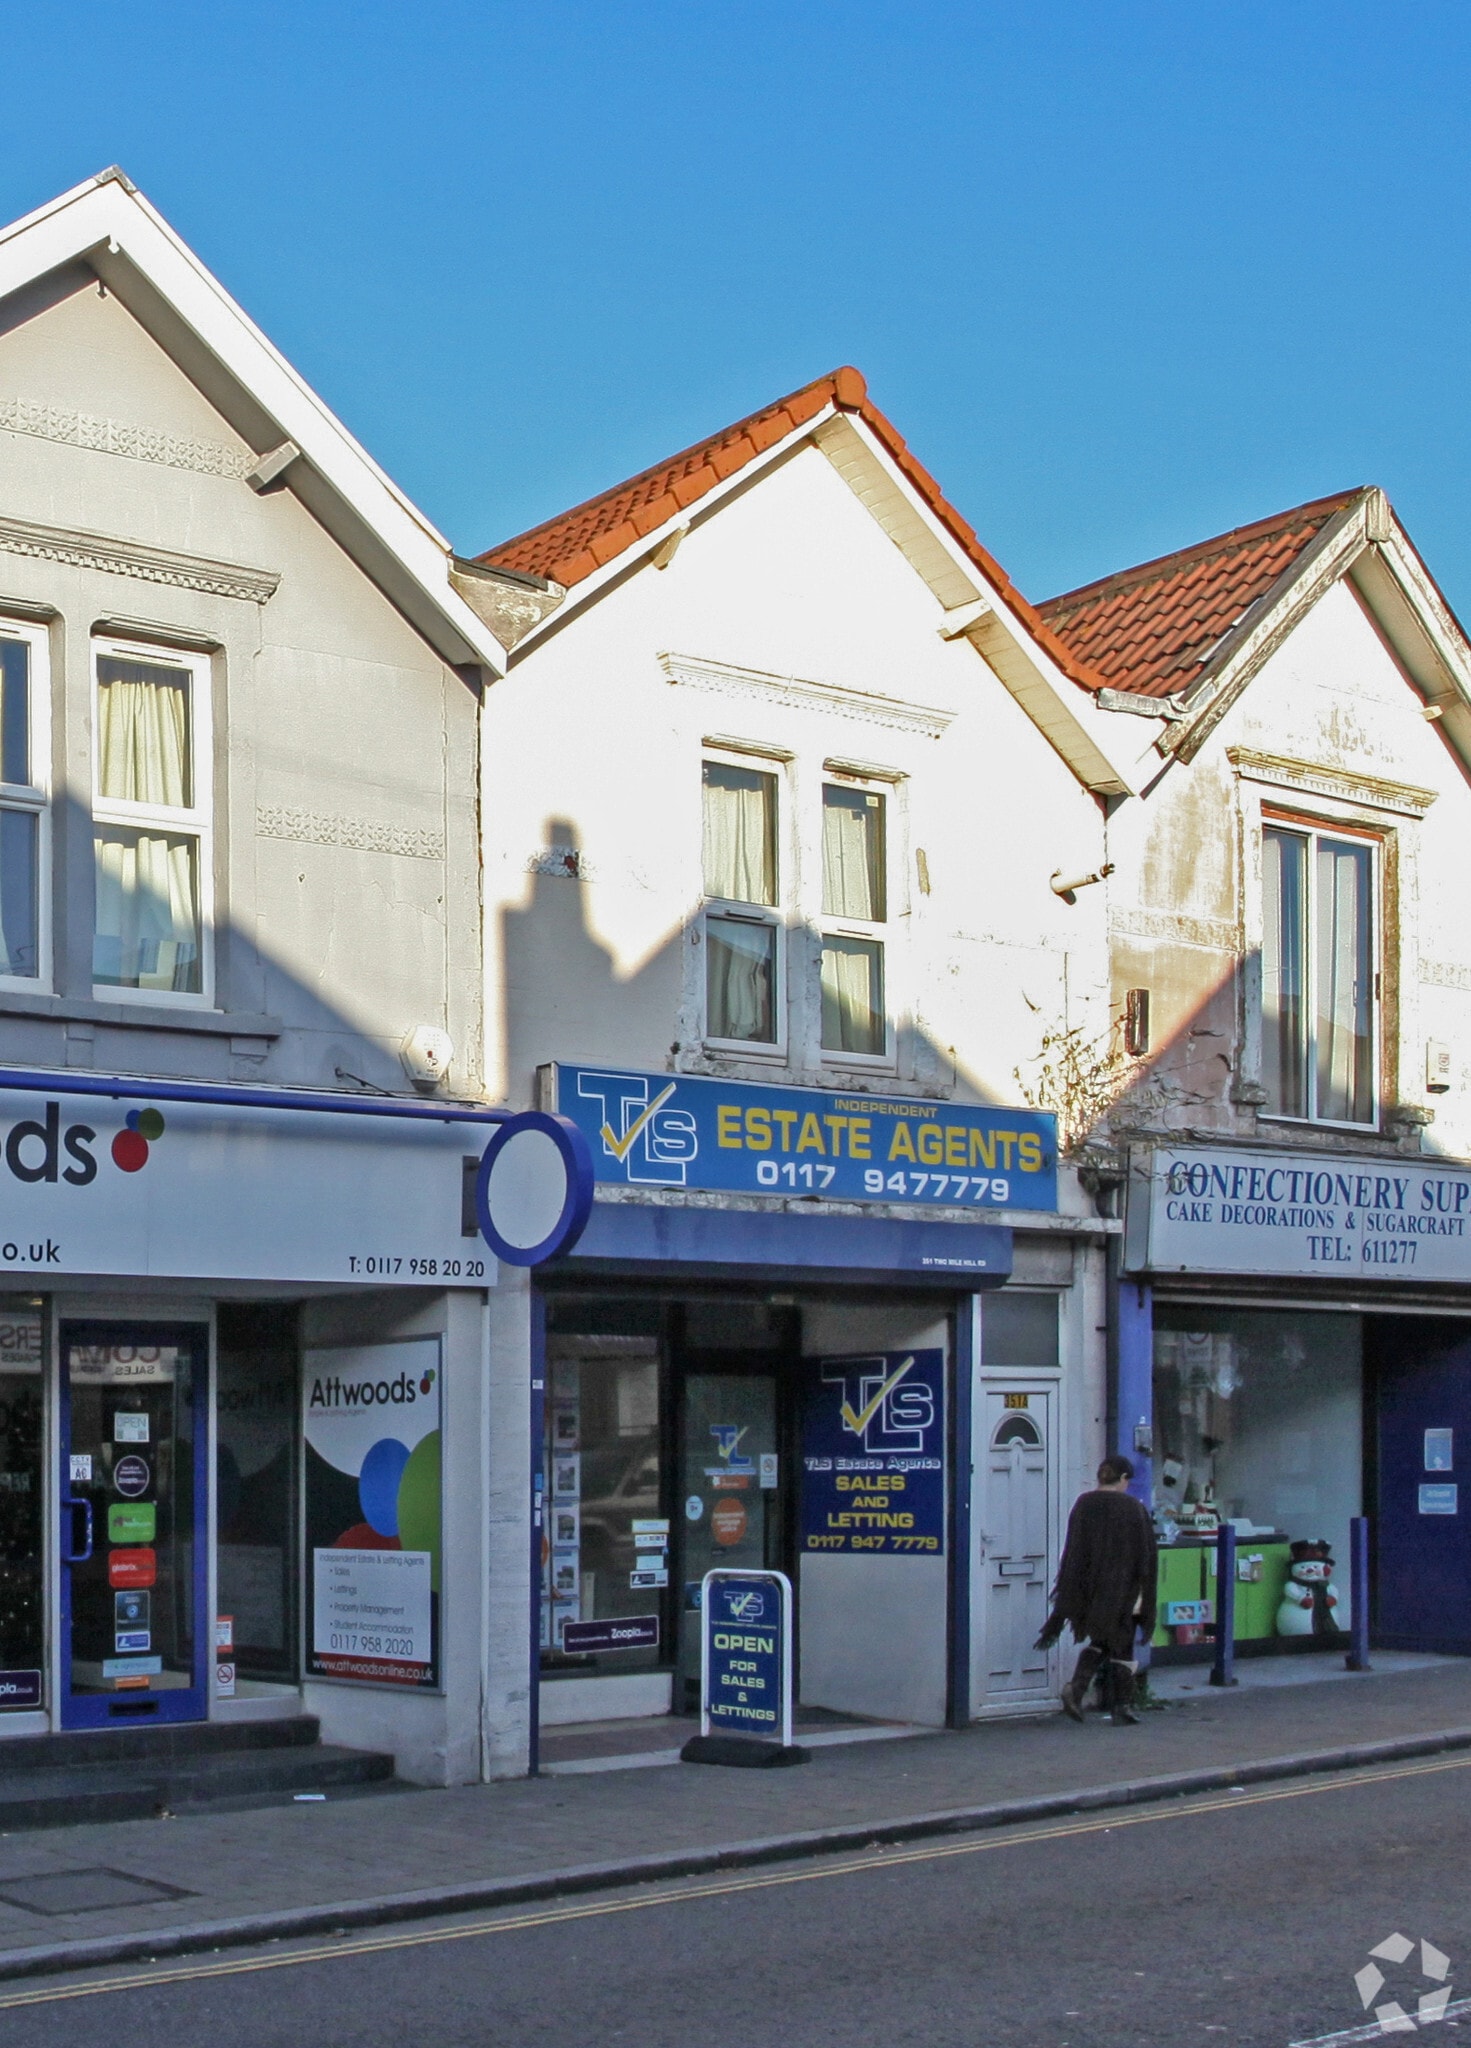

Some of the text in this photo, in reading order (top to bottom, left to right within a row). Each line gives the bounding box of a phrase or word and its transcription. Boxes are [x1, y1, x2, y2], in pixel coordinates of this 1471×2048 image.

[835, 1099, 938, 1118] INDEPENDENT
[0, 1101, 98, 1186] ds
[717, 1105, 1043, 1173] ESTATE AGENTS
[756, 1160, 1009, 1201] 0117 9477779
[1169, 1161, 1471, 1214] CONFECTIONERY SUP
[1167, 1201, 1465, 1236] CAKE DECORATIONS & SUGARCRAFT
[1307, 1236, 1418, 1264] TEL: 611277
[349, 1256, 360, 1273] T:
[366, 1257, 402, 1274] 0117
[410, 1258, 437, 1276] 958
[310, 1372, 416, 1407] Attwoods
[836, 1476, 906, 1491] SALES
[852, 1496, 889, 1508] AND
[827, 1513, 914, 1528] LETTING
[807, 1535, 938, 1549] 0117 947 7779
[330, 1634, 413, 1656] 0117 958 2020
[714, 1633, 774, 1654] OPEN
[312, 1659, 433, 1681] www.attwoodsonline.co.uk
[729, 1660, 757, 1672] FOR
[721, 1675, 765, 1689] SALES
[737, 1691, 747, 1702] &
[711, 1704, 775, 1721] LETTINGS
